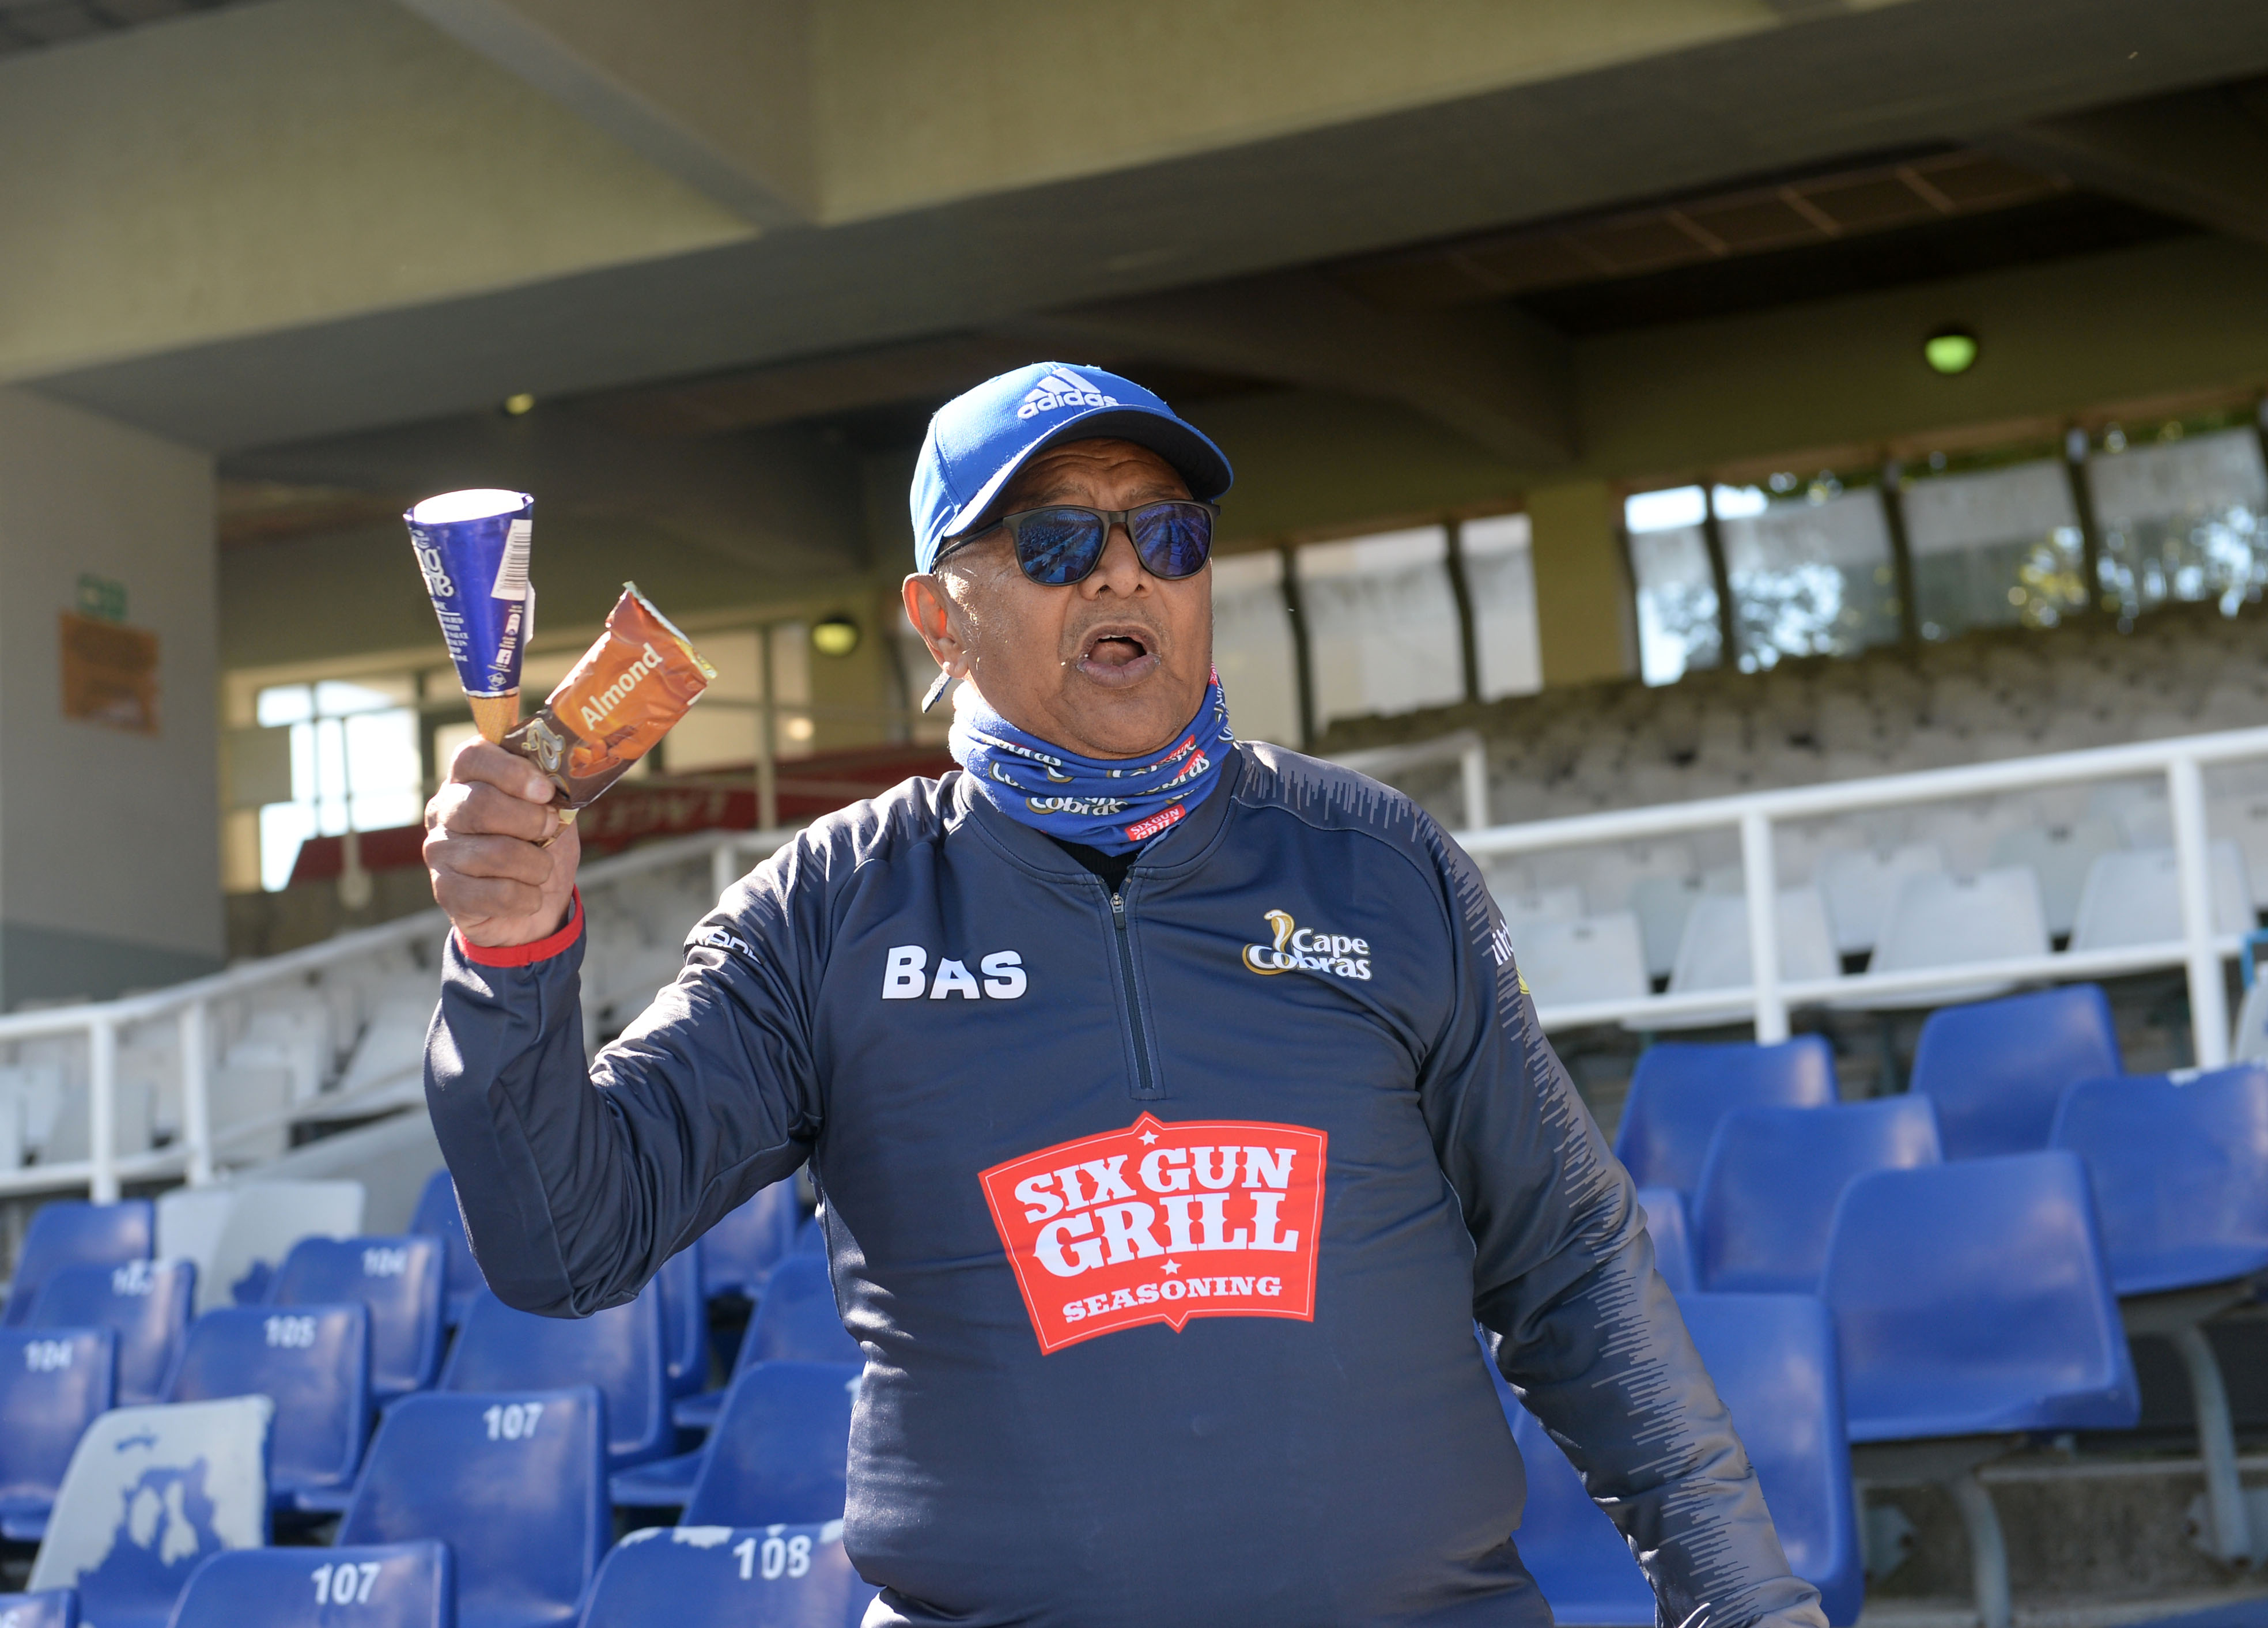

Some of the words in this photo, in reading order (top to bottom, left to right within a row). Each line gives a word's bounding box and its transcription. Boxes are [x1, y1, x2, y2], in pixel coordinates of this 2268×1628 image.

[1017, 388, 1119, 419] adidas
[581, 642, 663, 731] Almond
[1130, 822, 1152, 835] SIX
[1151, 809, 1180, 824] GUN
[1249, 945, 1371, 980] Cobras
[1292, 928, 1370, 958] Cape
[882, 945, 1027, 999] BAS
[1014, 1154, 1136, 1223] SIX
[1137, 1146, 1297, 1193] GUN
[1033, 1192, 1299, 1278] GRILL
[1062, 1276, 1282, 1324] SEASONING
[483, 1402, 543, 1440] 107
[733, 1536, 811, 1580] 108
[311, 1562, 382, 1605] 107
